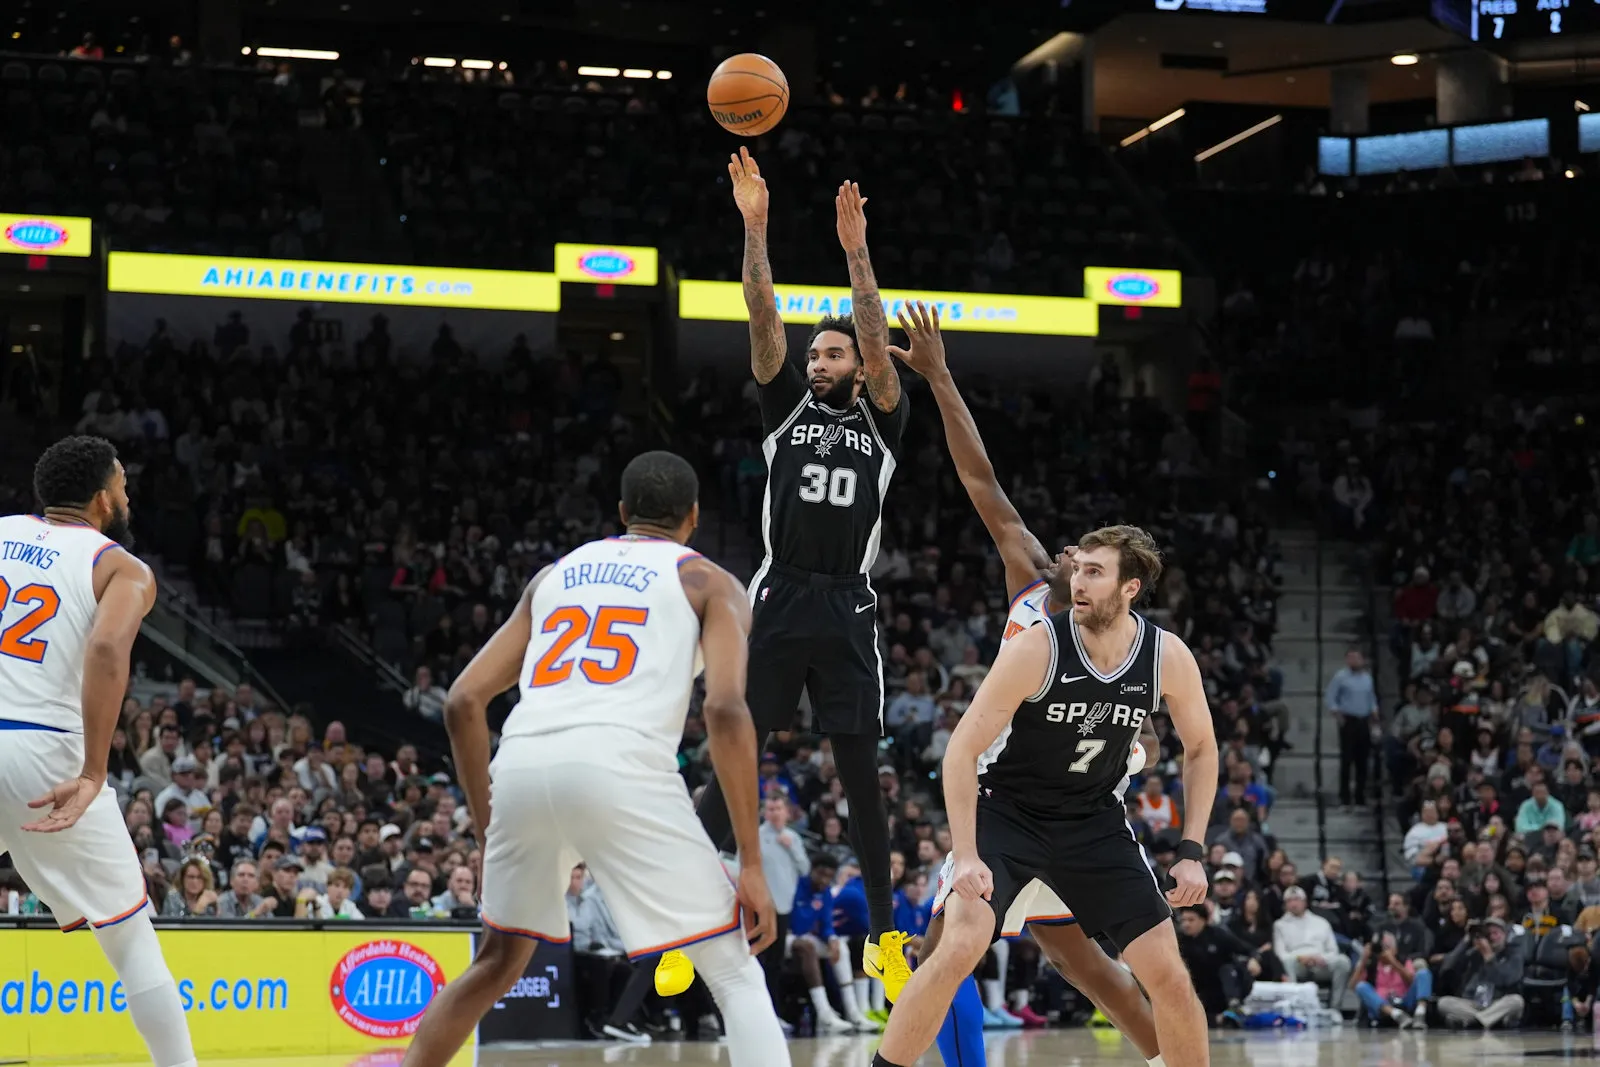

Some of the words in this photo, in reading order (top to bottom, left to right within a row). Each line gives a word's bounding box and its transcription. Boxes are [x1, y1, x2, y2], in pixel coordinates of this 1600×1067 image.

[1493, 17, 1505, 39] 7
[713, 109, 763, 125] Wilson
[202, 267, 474, 296] AHIABENEFITS.com
[790, 424, 873, 458] SPURS
[798, 463, 858, 508] 30
[3, 541, 61, 570] TOWNS
[563, 562, 659, 593] BRIDGES
[0, 575, 62, 664] 2
[528, 605, 650, 688] 25
[1122, 685, 1145, 693] LEDGER
[1045, 702, 1147, 736] SPURS
[1067, 739, 1107, 774] 7
[0, 969, 288, 1015] abenes.com
[351, 968, 424, 1006] AHIA
